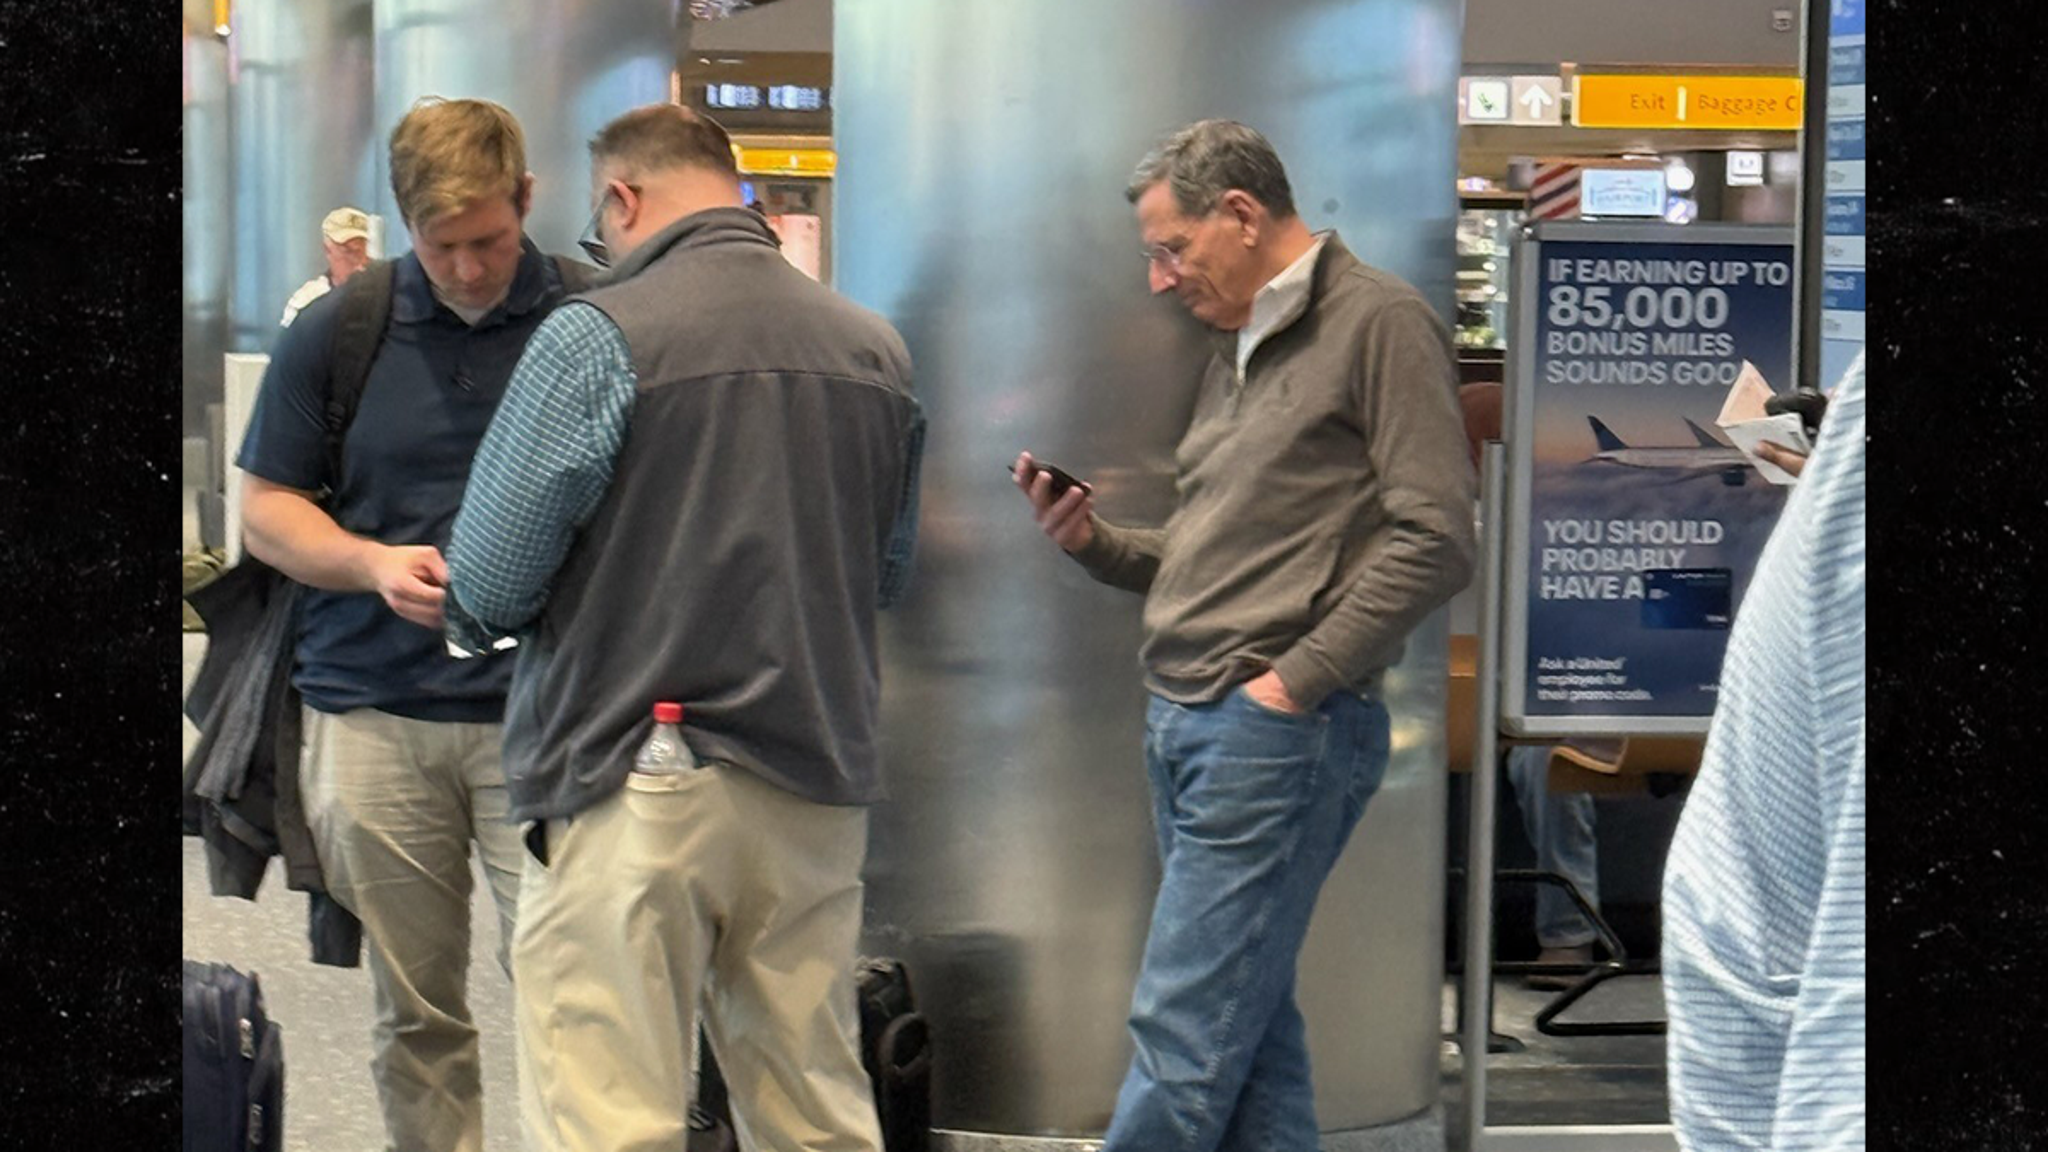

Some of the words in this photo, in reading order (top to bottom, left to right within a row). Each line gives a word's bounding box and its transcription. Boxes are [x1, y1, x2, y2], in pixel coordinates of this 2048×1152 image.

[1631, 93, 1665, 110] Exit
[1698, 94, 1777, 116] Baggage
[1549, 259, 1572, 283] IF
[1576, 260, 1706, 285] EARNING
[1710, 261, 1749, 285] UP
[1753, 262, 1789, 286] TO
[1548, 285, 1730, 330] 85,000
[1548, 331, 1648, 356] BONUS
[1652, 333, 1735, 357] MILES
[1546, 360, 1669, 384] SOUNDS
[1672, 361, 1738, 386] GOO
[1543, 519, 1604, 545] YOU
[1607, 519, 1724, 545] SHOULD
[1541, 547, 1687, 571] PROBABLY
[1541, 574, 1620, 600] HAVE
[1622, 575, 1645, 600] A
